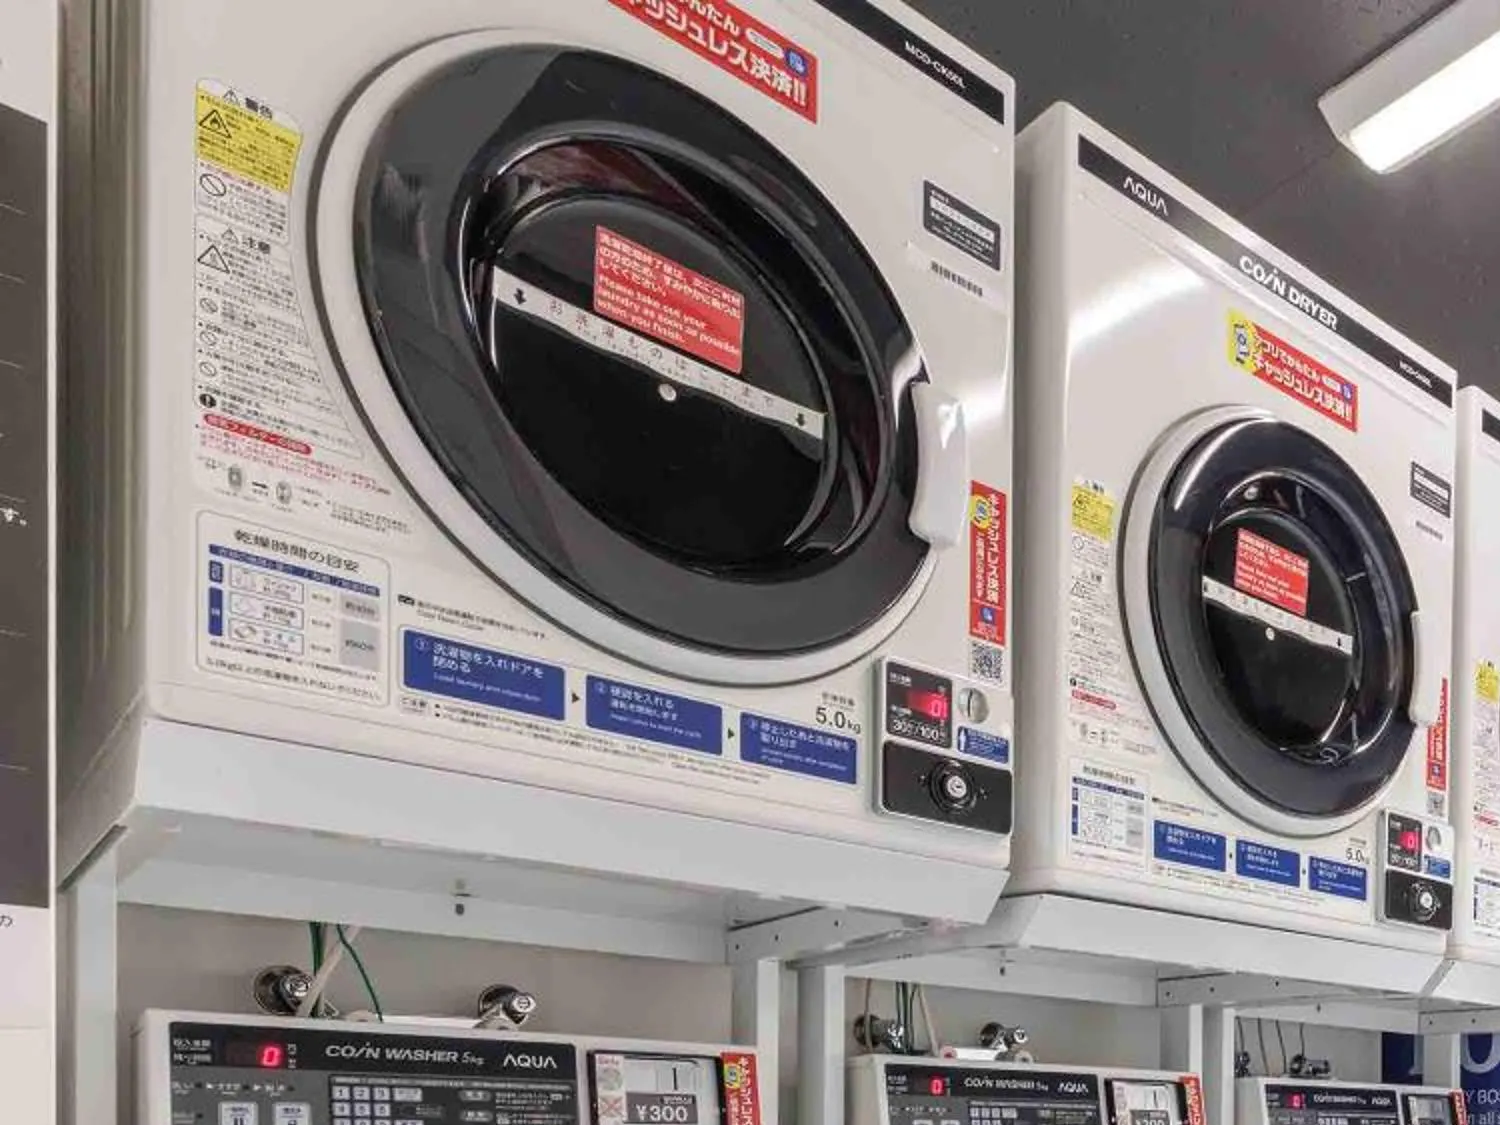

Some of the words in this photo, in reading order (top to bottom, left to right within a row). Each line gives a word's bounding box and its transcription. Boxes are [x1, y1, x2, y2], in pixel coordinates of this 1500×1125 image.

[681, 0, 741, 37] んたん
[629, 0, 807, 107] ッシュレス決済!!
[1123, 175, 1169, 216] AQUA
[1288, 287, 1338, 330] DRYER
[815, 706, 862, 735] 5.0kg
[261, 1046, 282, 1067] 0
[385, 1047, 459, 1064] WASHER
[503, 1053, 558, 1069] AQUA
[636, 1105, 689, 1122] ¥300
[1479, 1110, 1495, 1125] all
